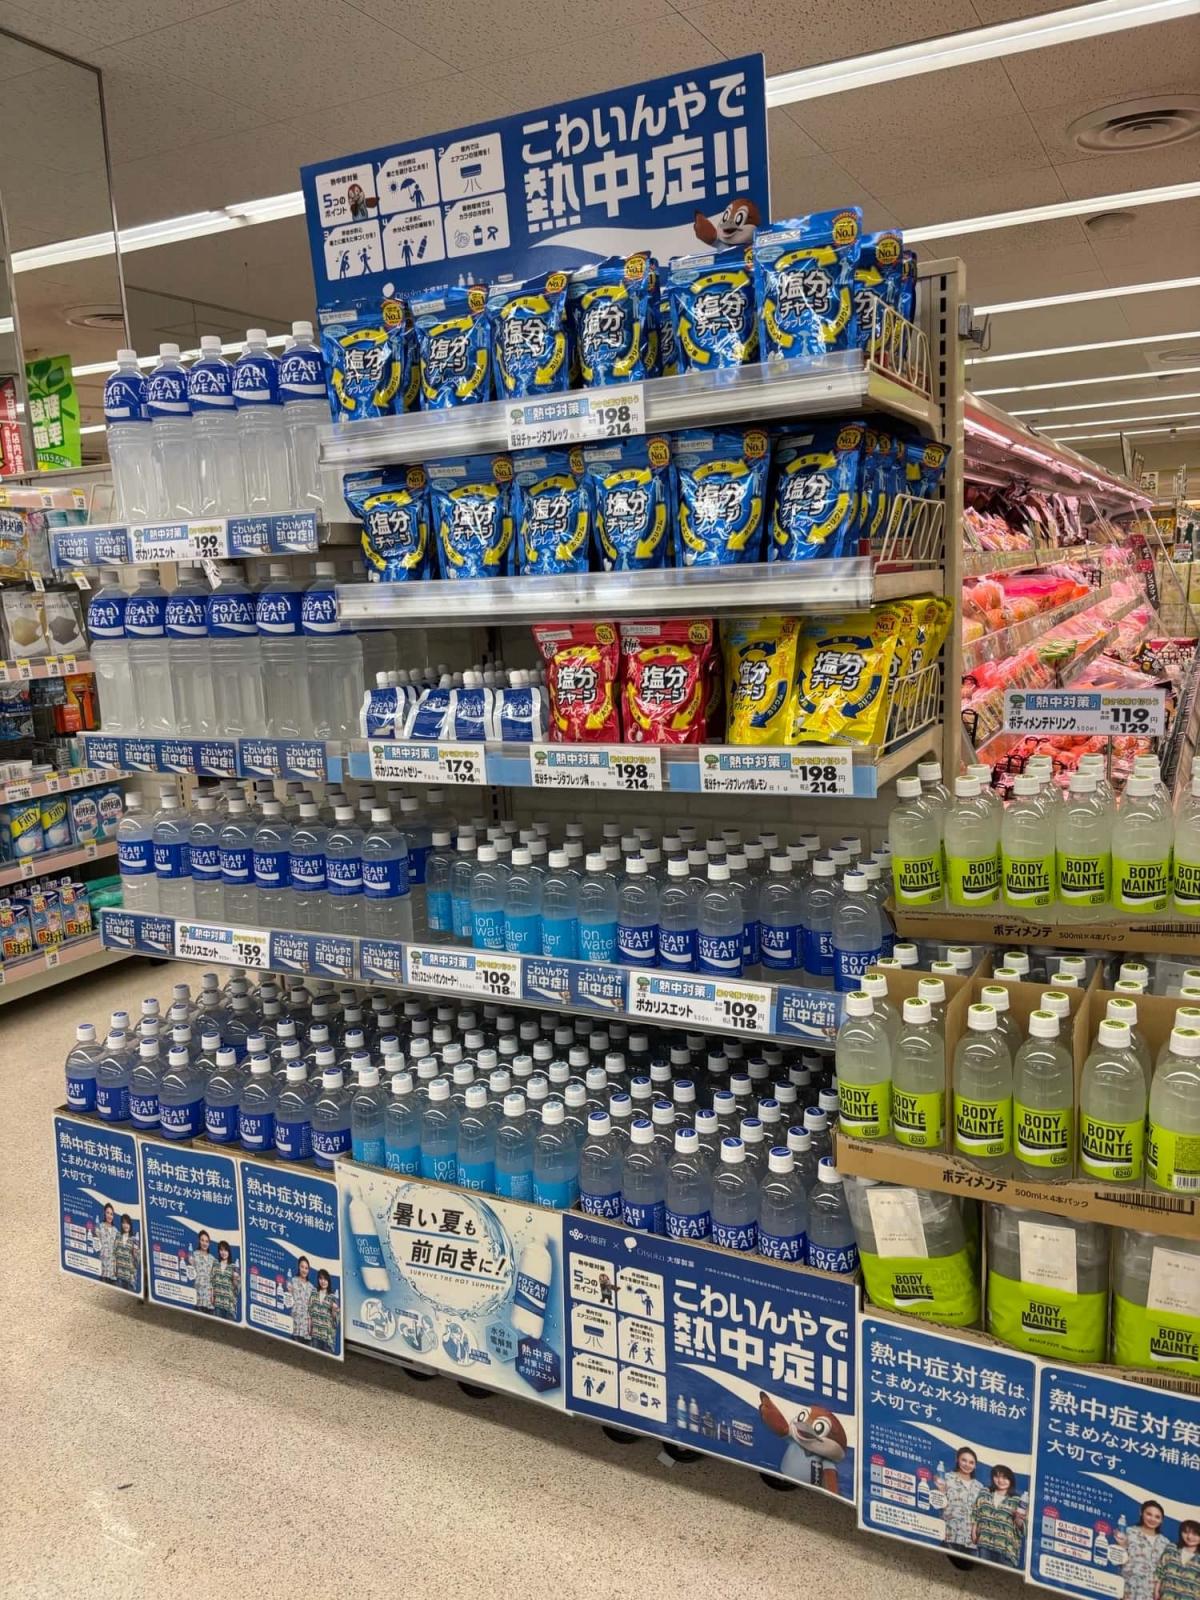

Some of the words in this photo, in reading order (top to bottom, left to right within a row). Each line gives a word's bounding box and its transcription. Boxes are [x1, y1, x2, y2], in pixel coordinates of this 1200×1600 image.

[521, 72, 747, 163] こわいんやで
[524, 126, 749, 233] 熱中症!!
[323, 193, 346, 208] 5つの
[325, 206, 347, 218] ポイント
[835, 228, 855, 239] No.1
[878, 247, 898, 259] No.1
[780, 270, 830, 300] 塩分
[696, 293, 745, 320] 塩分
[781, 299, 829, 317] チャージ
[584, 305, 624, 334] 塩分
[696, 317, 743, 336] チャージ
[504, 318, 547, 345] 塩分
[430, 336, 468, 360] 塩分
[584, 332, 623, 352] チャージ
[344, 347, 384, 370] 塩分
[505, 344, 546, 359] チャージ
[429, 358, 466, 374] チャージ
[344, 369, 383, 386] チャージ
[596, 406, 631, 425] 198
[607, 422, 631, 436] 214
[652, 452, 668, 461] No.1
[785, 475, 831, 500] 塩分
[532, 498, 568, 521] 塩分
[607, 490, 648, 516] 塩分
[783, 498, 826, 517] チャージ
[370, 511, 410, 535] 塩分
[453, 503, 494, 528] 塩分
[607, 513, 647, 533] チャージ
[232, 523, 267, 535] こわいんやで
[276, 519, 313, 531] こわいんやで
[453, 523, 493, 542] チャージ
[530, 519, 566, 536] チャージ
[194, 535, 218, 549] 199
[375, 532, 412, 549] チャージ
[136, 546, 175, 560] ポカリスエット
[202, 548, 219, 558] 215
[165, 613, 204, 624] SWEAT
[692, 631, 708, 640] No.1
[813, 651, 866, 675] 塩分
[558, 667, 598, 690] 塩分
[641, 666, 688, 689] 塩分
[738, 661, 771, 686] 塩分
[811, 673, 860, 691] チャージ
[558, 689, 596, 705] チャージ
[641, 688, 685, 705] チャージ
[736, 683, 766, 701] チャージ
[1029, 695, 1098, 708] 「熱中対策」
[1009, 716, 1077, 730] ボディメンテドリンク
[1110, 708, 1150, 723] 119
[1120, 723, 1150, 733] 129
[89, 742, 117, 752] こわいんやで
[446, 759, 474, 773] 179
[722, 755, 788, 769] 「熱中対策」
[375, 766, 422, 778] ポカリスエットゼリー
[454, 774, 475, 783] 194
[615, 764, 648, 778] 198
[800, 766, 837, 781] 198
[625, 779, 648, 790] 214
[810, 782, 837, 793] 214
[18, 809, 39, 829] Fitty
[49, 804, 66, 822] Fitty
[904, 861, 934, 874] BODY
[1011, 861, 1043, 875] BODY
[1129, 865, 1162, 879] BODY
[105, 917, 135, 928] こわいんやで
[475, 914, 494, 928] ion
[581, 927, 599, 940] ion
[994, 924, 1052, 938] ボディメンテ
[180, 944, 218, 958] ポカリスエット
[238, 943, 261, 957] 159
[244, 956, 261, 966] 172
[482, 970, 510, 985] 109
[527, 964, 569, 978] こわいんやで
[578, 971, 622, 985] こわいんやで
[490, 984, 511, 995] 118
[653, 979, 712, 1000] 「熱中対策」
[635, 999, 693, 1018] ポカリスエット
[722, 1000, 757, 1017] 109
[783, 996, 836, 1012] こわいんやで
[732, 1016, 757, 1029] 118
[840, 1088, 870, 1103] BODY
[962, 1103, 997, 1120] BODY
[1024, 1113, 1060, 1130] BODY
[1088, 1123, 1125, 1143] BODY
[59, 1131, 135, 1166] 熱中症対策は、
[1082, 1133, 1133, 1156] MAINTÉ
[61, 1152, 134, 1181] こまめな水分補給が
[146, 1157, 234, 1190] 熱中症対策は、
[61, 1167, 97, 1187] 大切です。
[148, 1179, 233, 1206] こまめな水分補給が
[943, 1169, 1008, 1192] ボディメンテ
[1015, 1188, 1089, 1208] 500ml×4本パック
[149, 1194, 189, 1214] 大切です。
[247, 1177, 335, 1218] 熱中症対策は、
[248, 1199, 335, 1233] こまめな水分補給が
[393, 1202, 476, 1236] 暑い夏も
[248, 1215, 290, 1238] 大切です。
[584, 1234, 607, 1247] 大阪府
[410, 1239, 506, 1276] 前向きに!
[410, 1269, 438, 1280] SURVIVE
[440, 1275, 452, 1283] THE
[454, 1278, 469, 1286] HOT
[517, 1275, 549, 1295] POCARI
[573, 1269, 598, 1287] 5つの
[895, 1274, 923, 1287] BODY
[517, 1284, 546, 1302] SWEAT
[573, 1283, 599, 1296] ポイント
[673, 1279, 850, 1353] こわいんやで
[1029, 1302, 1061, 1318] BODY
[1158, 1327, 1192, 1344] BODY
[521, 1343, 554, 1363] 熱中症
[673, 1312, 848, 1402] 熱中症!!
[523, 1358, 552, 1372] 対策には
[870, 1341, 1031, 1402] 熱中症対策は、
[519, 1365, 557, 1384] ポカリスエット
[871, 1369, 1026, 1420] こまめな水分補給が
[871, 1390, 942, 1422] 大切です。
[1047, 1439, 1126, 1475] 大切です。
